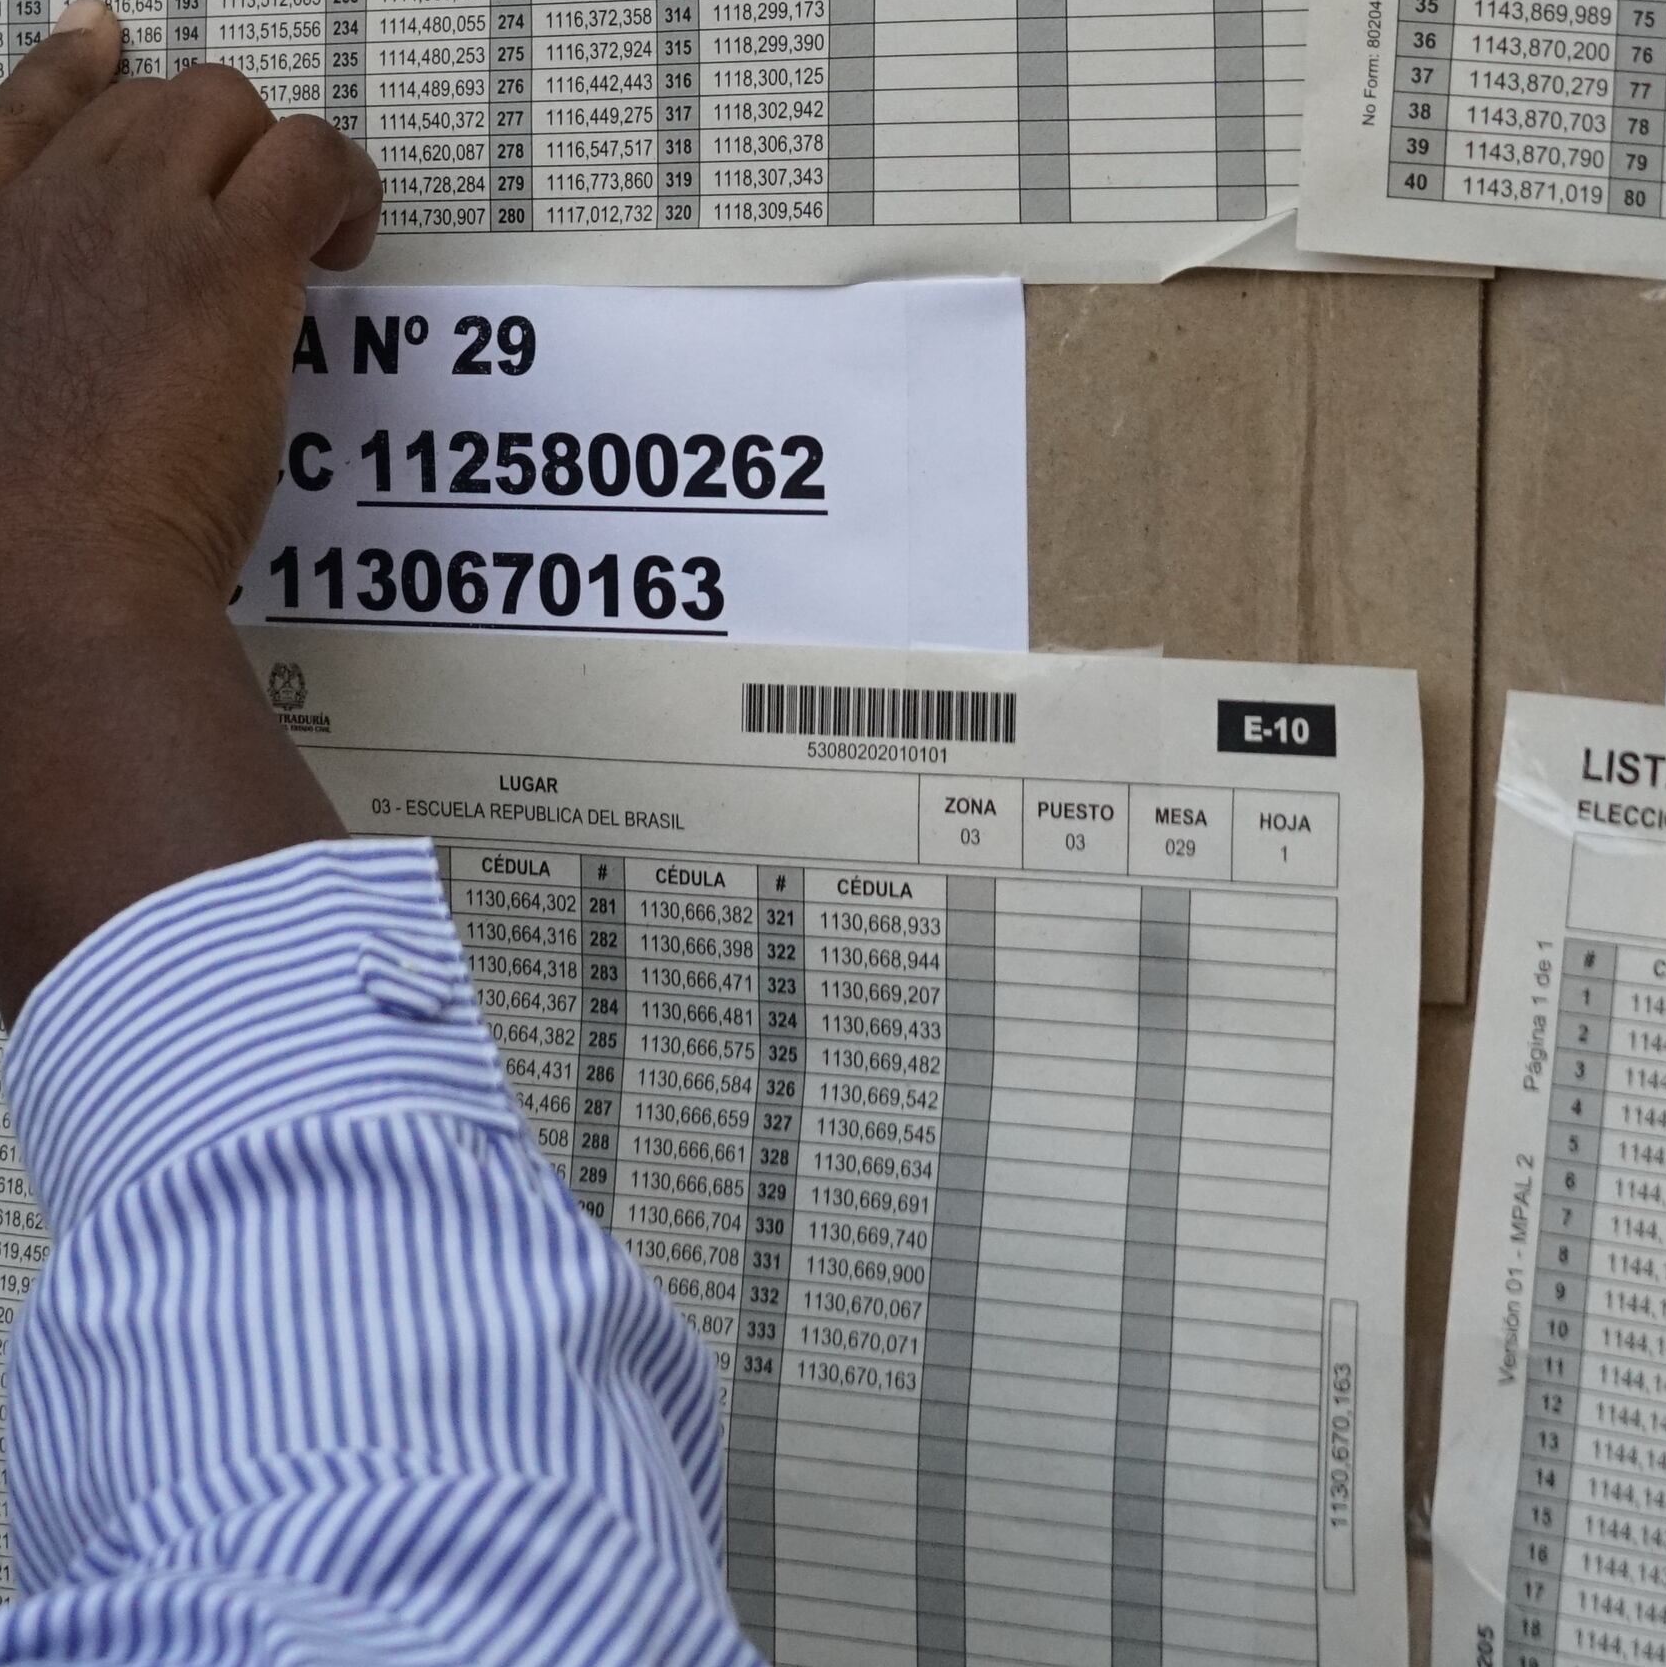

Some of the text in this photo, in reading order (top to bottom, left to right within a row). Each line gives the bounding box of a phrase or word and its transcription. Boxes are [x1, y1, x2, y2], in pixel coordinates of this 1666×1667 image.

[664, 0, 824, 24] 314 1118,299,173
[1404, 173, 1602, 204] 40 1143,871,019
[547, 201, 822, 226] 1117,012,732 320 1118,309,546
[452, 315, 535, 376] 29
[360, 428, 825, 500] 1125800262
[269, 545, 726, 621] 1130670163
[1244, 716, 1309, 744] E-10
[808, 742, 946, 764] 53080202010101
[500, 775, 558, 793] LUGAR
[372, 798, 391, 814] 03
[406, 799, 485, 818] ESCUELA
[490, 803, 583, 825] REPUBLICA
[588, 809, 619, 826] DEL
[625, 811, 685, 830] BRASIL
[945, 796, 997, 816] ZONA
[1038, 801, 1114, 822] PUESTO
[1156, 807, 1207, 827] MESA
[1260, 812, 1311, 833] HOJA
[961, 828, 980, 845] 03
[1066, 833, 1085, 852] 03
[1165, 838, 1195, 857] 029
[1281, 845, 1287, 863] 1
[837, 875, 913, 899] CÉDULA
[767, 909, 940, 937] 321 1130,668,933
[743, 1352, 916, 1391] 334 1130,670,163
